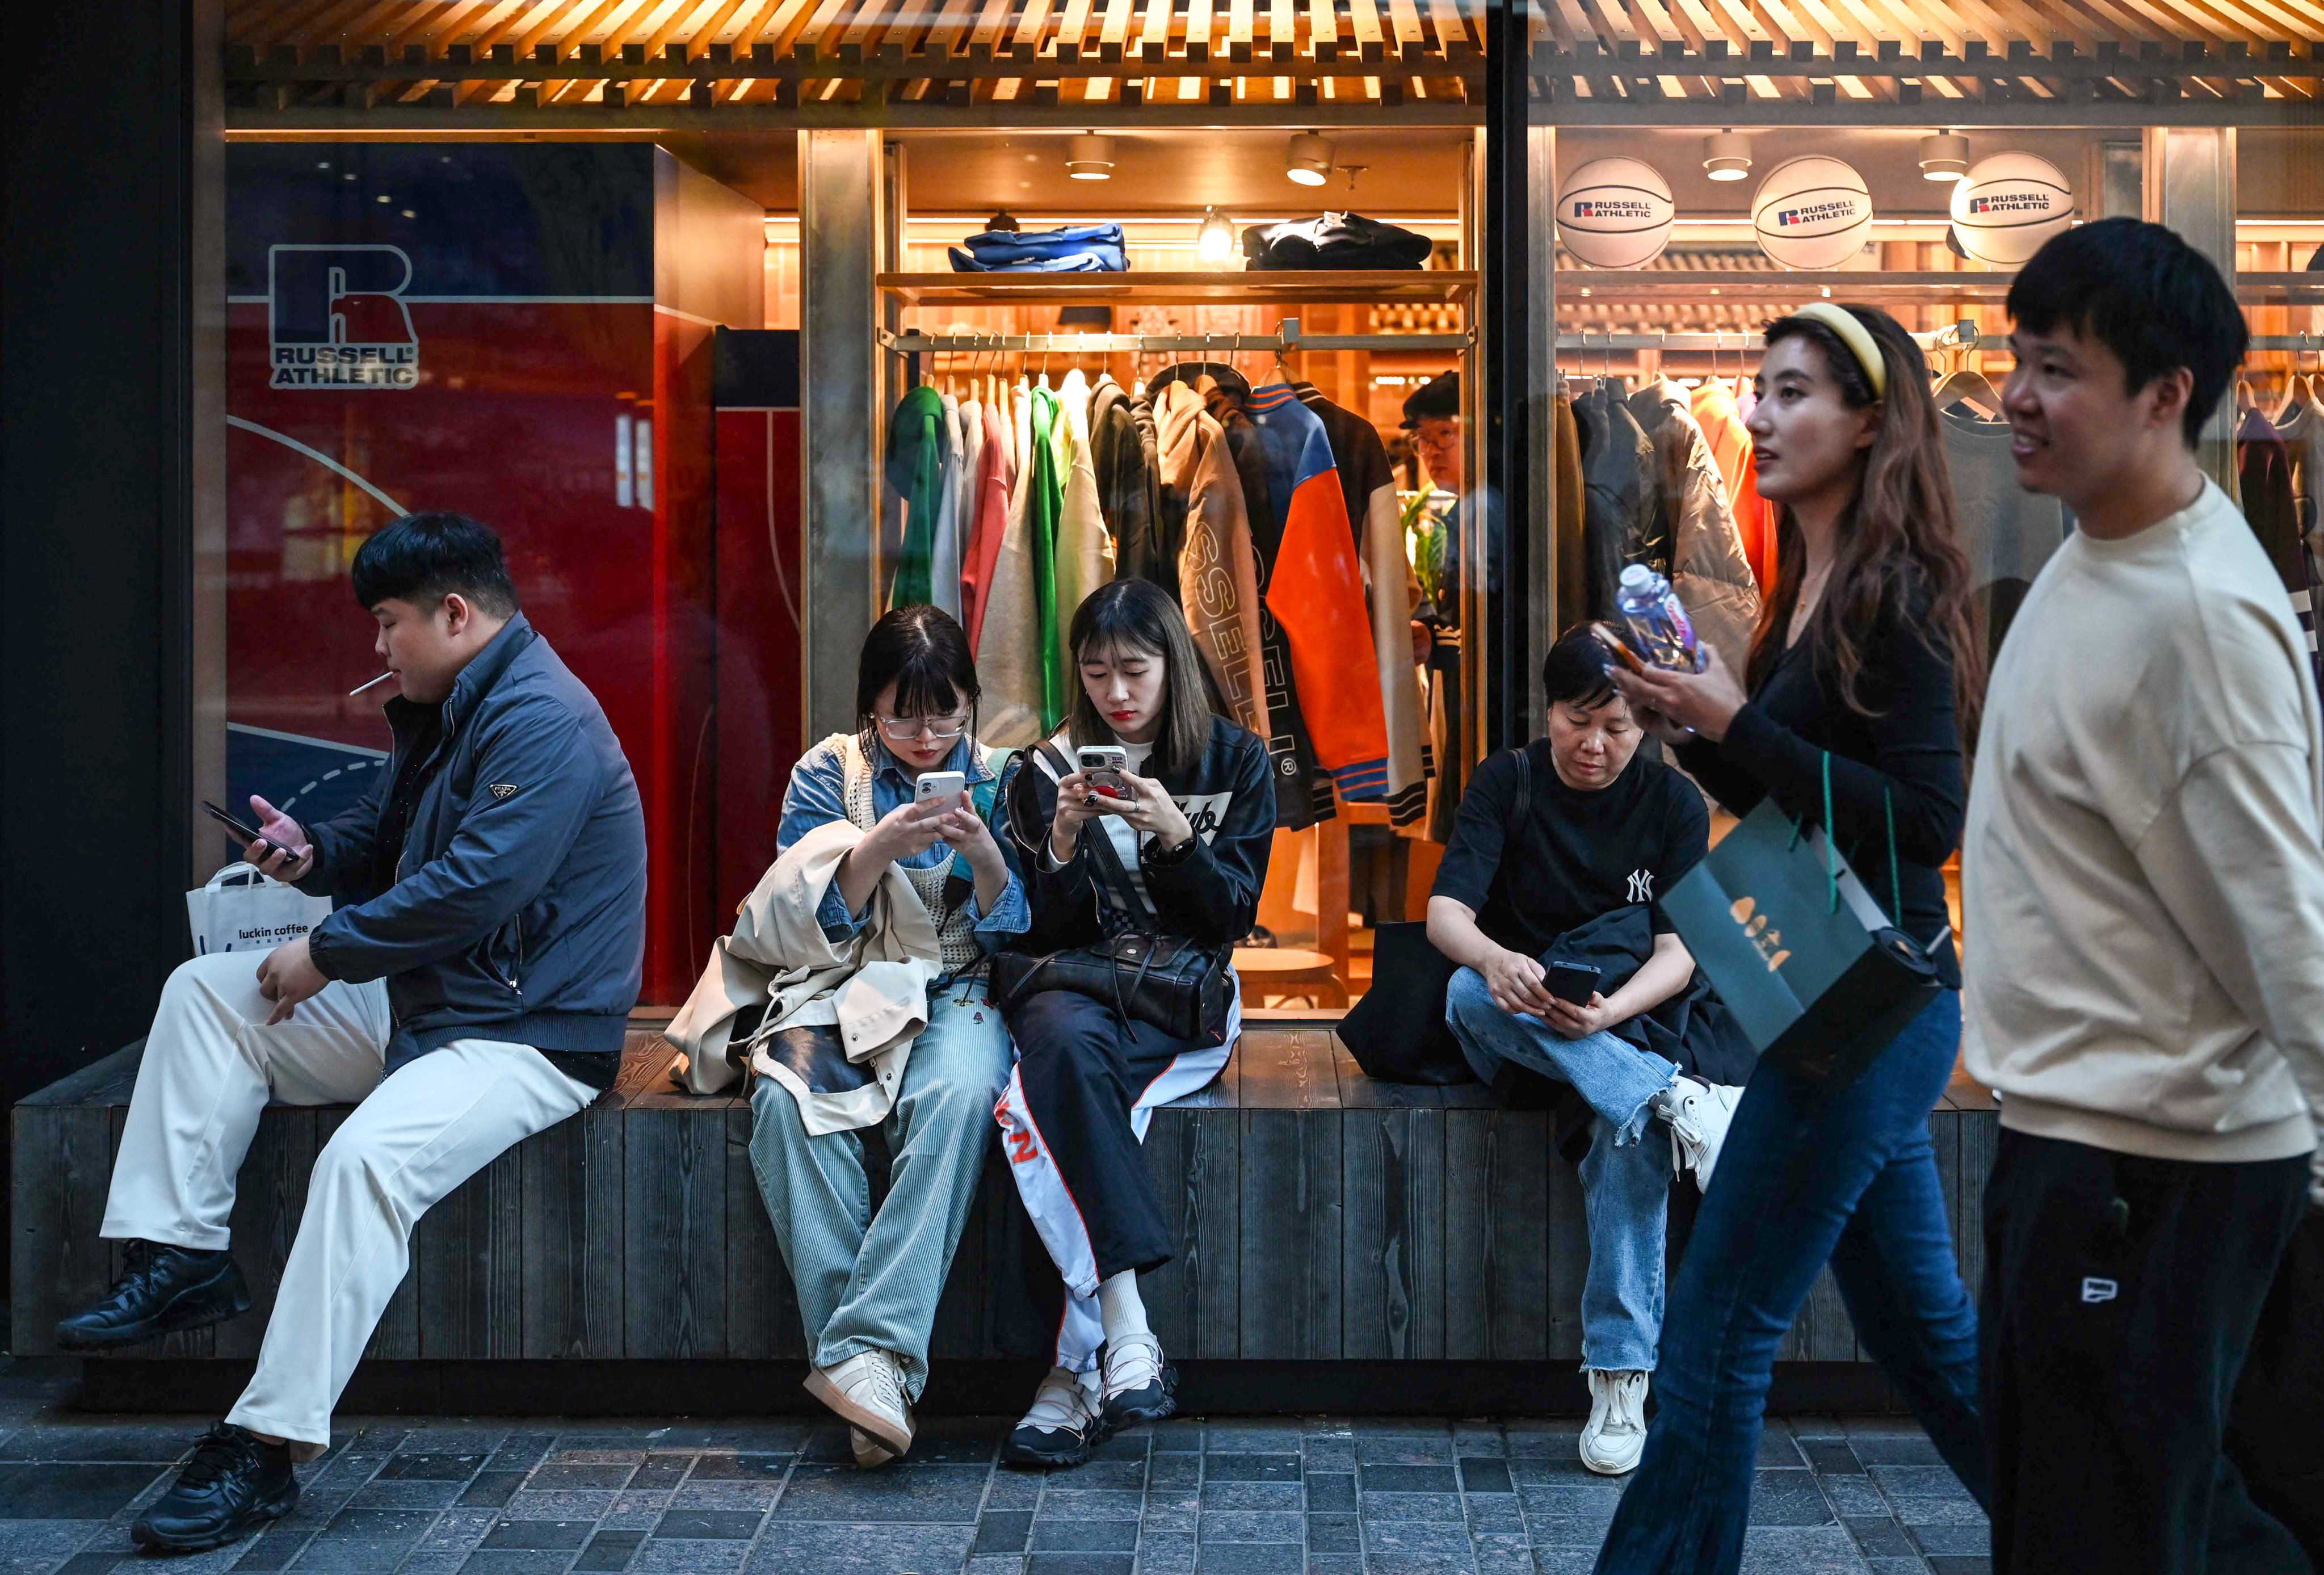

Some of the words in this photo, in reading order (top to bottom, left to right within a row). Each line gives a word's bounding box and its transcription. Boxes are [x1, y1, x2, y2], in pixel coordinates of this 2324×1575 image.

[1991, 194, 2049, 203] RUSSELL
[1801, 200, 1855, 215] RUSSELL
[1991, 202, 2050, 211] ATHLETIC
[1802, 208, 1856, 223] ATHLETIC
[275, 368, 414, 384] ATHLETIC
[1172, 800, 1221, 834] ub
[1626, 869, 1655, 903] NY
[239, 927, 271, 939] luckin
[274, 924, 309, 936] coffee
